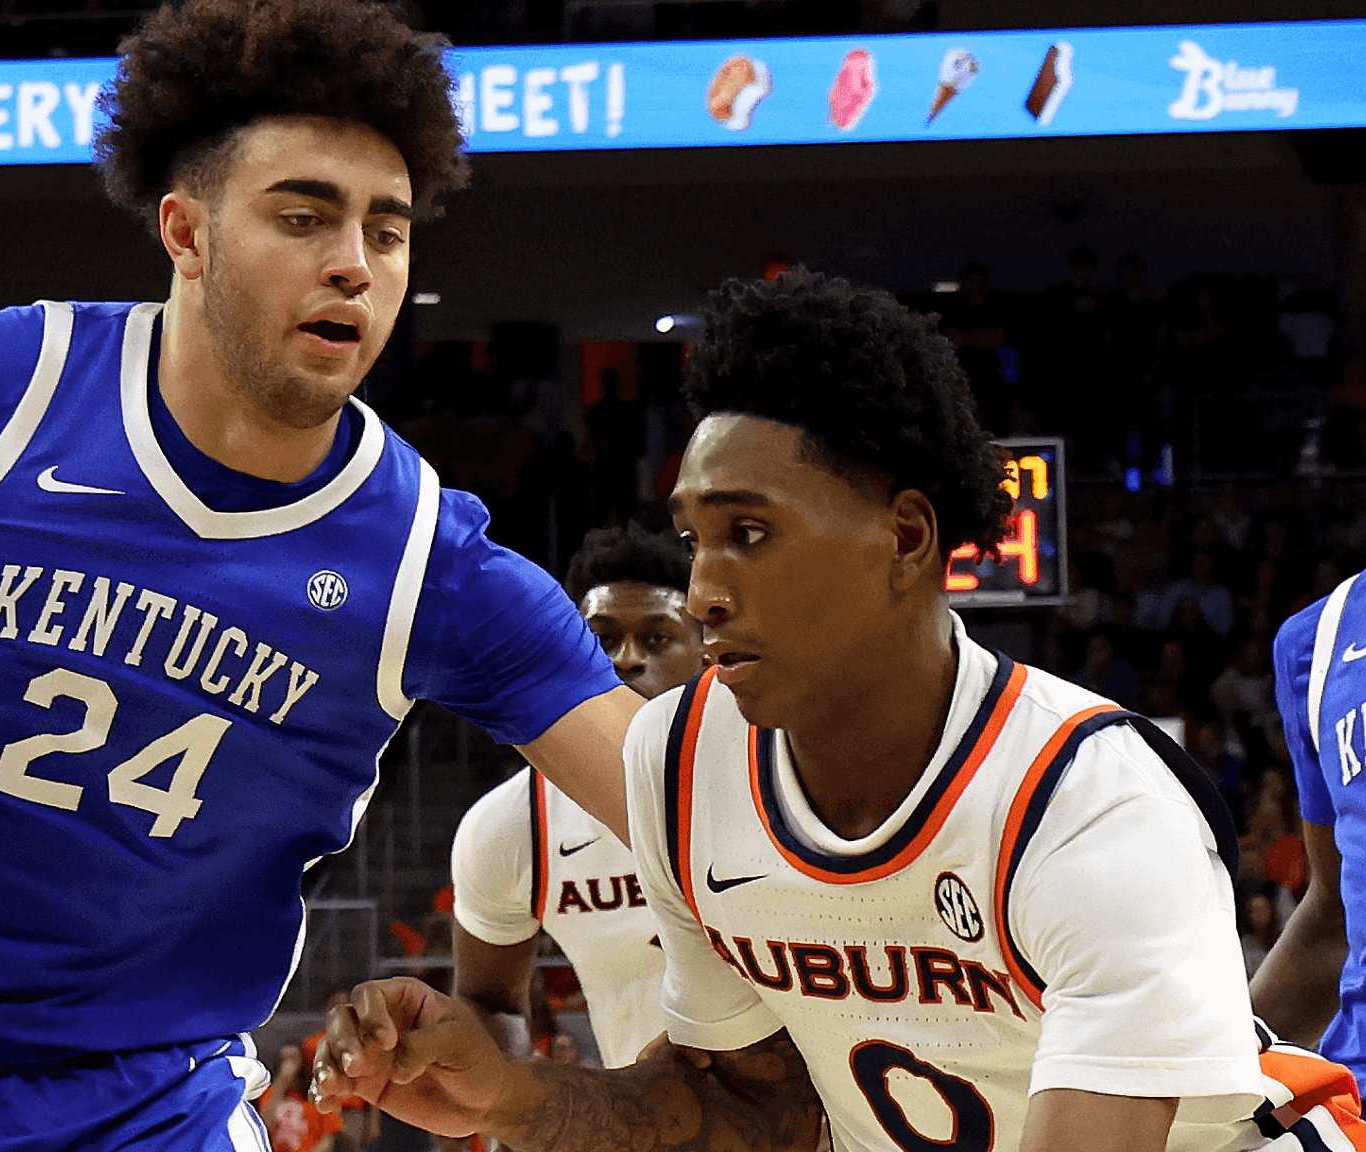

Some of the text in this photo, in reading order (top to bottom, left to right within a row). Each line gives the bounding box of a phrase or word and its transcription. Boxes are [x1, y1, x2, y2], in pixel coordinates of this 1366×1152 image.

[309, 573, 346, 608] SEC
[937, 876, 981, 939] SEC
[702, 925, 1028, 1021] AUBURN
